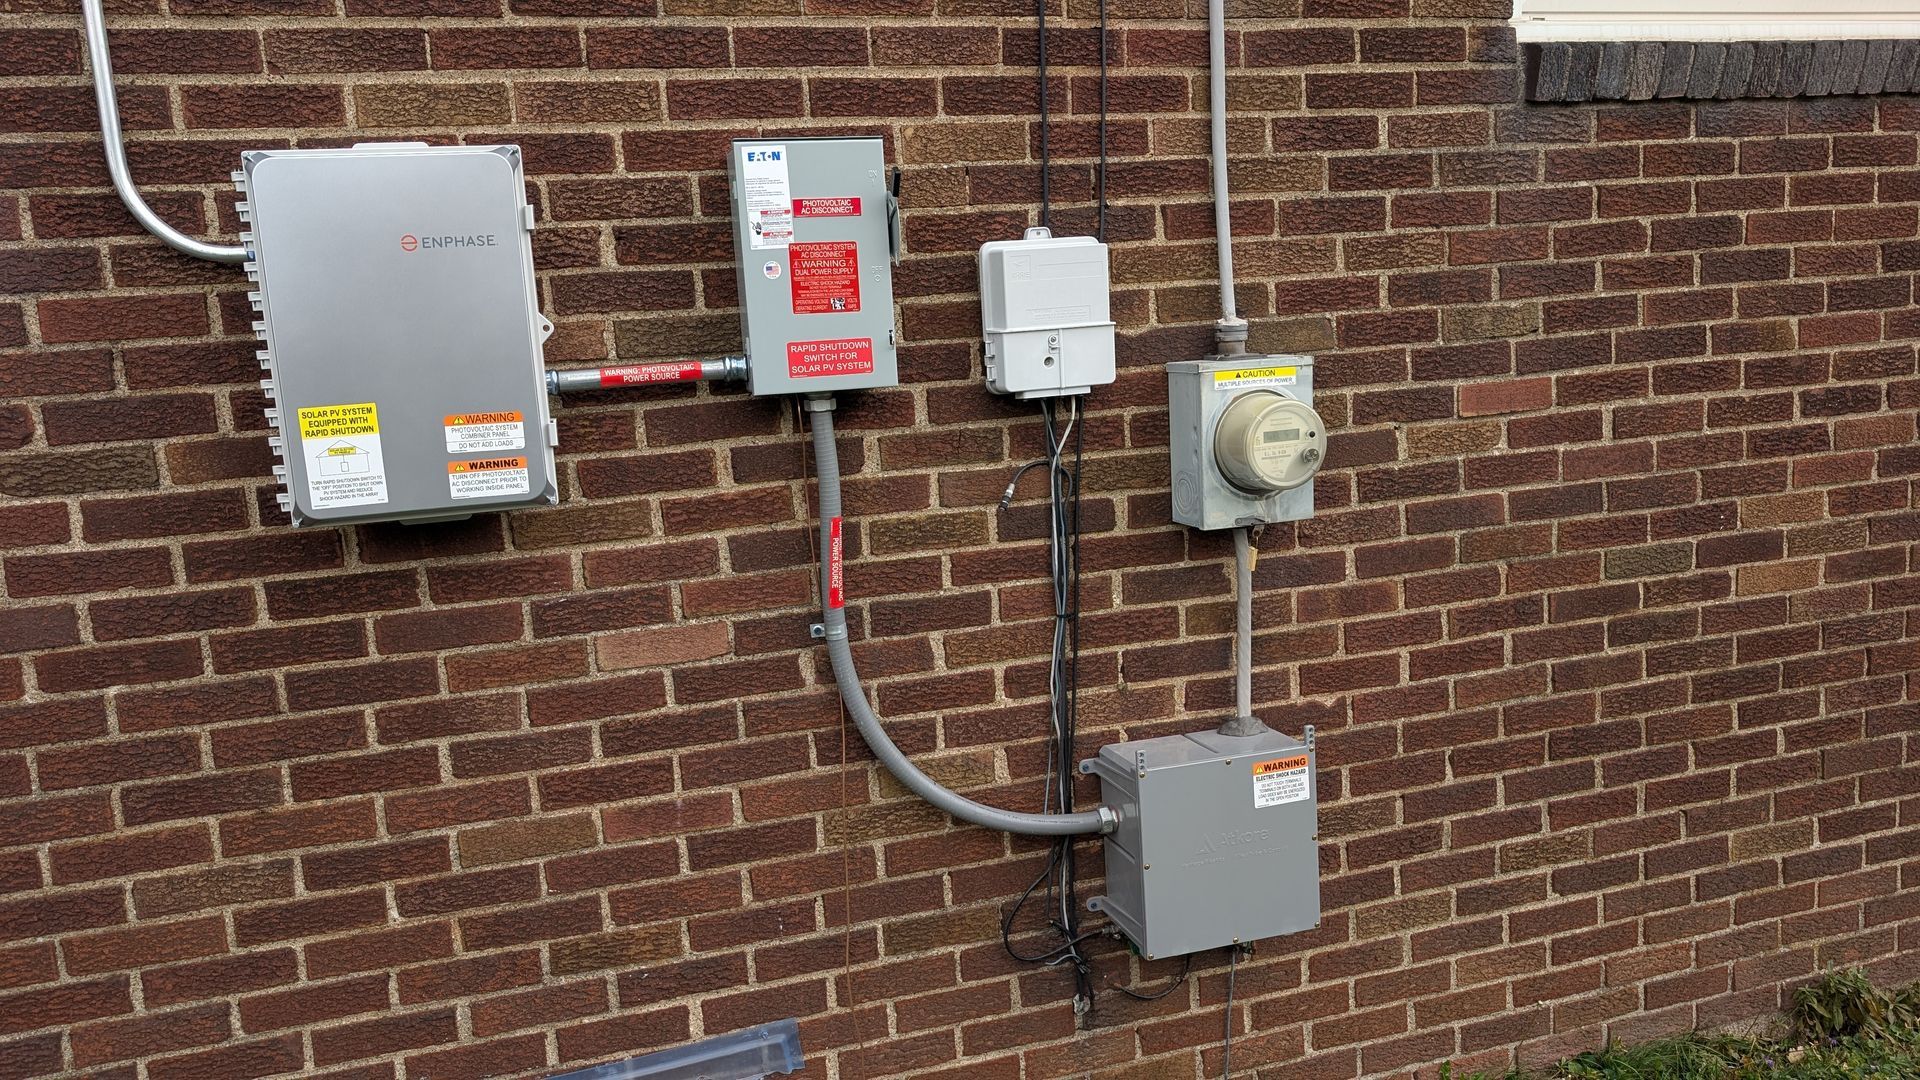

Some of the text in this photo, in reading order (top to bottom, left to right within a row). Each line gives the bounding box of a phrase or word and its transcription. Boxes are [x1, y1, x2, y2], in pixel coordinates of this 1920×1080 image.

[422, 235, 495, 248] ENPHASE
[790, 341, 869, 352] RAPID SHUTDOWN
[804, 353, 837, 362] SWITCH
[604, 363, 695, 376] WARNING: PHOTOVOLTAIC
[791, 364, 820, 373] SOLAR
[836, 361, 871, 370] SYSTEM
[623, 372, 680, 382] POWER SOURCE
[1243, 370, 1276, 378] CAUTION
[302, 411, 328, 419] SOLAR
[342, 407, 372, 416] SYSTEM
[465, 412, 515, 424] WARNING
[309, 418, 347, 428] EQUIPPED
[305, 426, 374, 438] RAPID SHUTDOWN
[469, 459, 518, 470] WARNING
[461, 478, 498, 486] DISCONNECT
[1264, 758, 1306, 771] WARNING
